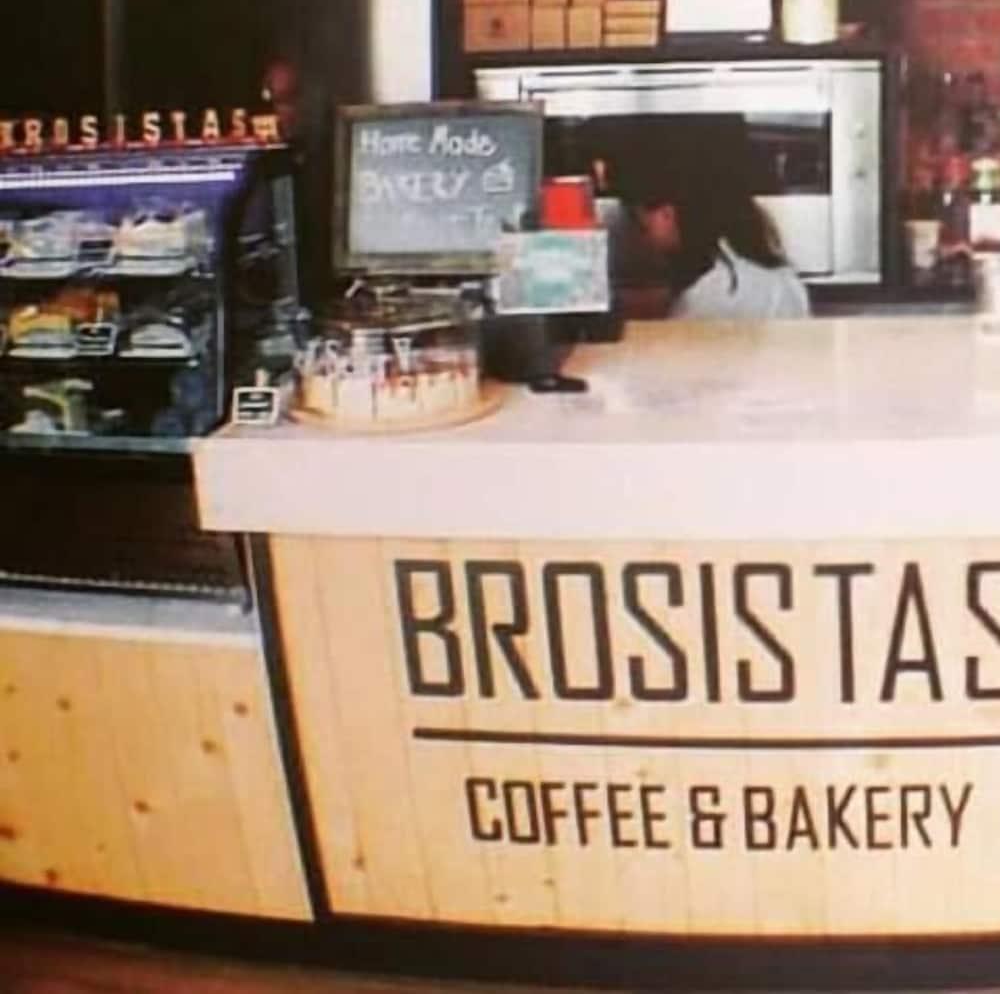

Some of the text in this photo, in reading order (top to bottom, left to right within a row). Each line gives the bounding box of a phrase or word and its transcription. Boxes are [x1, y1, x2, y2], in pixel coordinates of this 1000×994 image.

[466, 776, 974, 851] COFFEE & BAKERY
